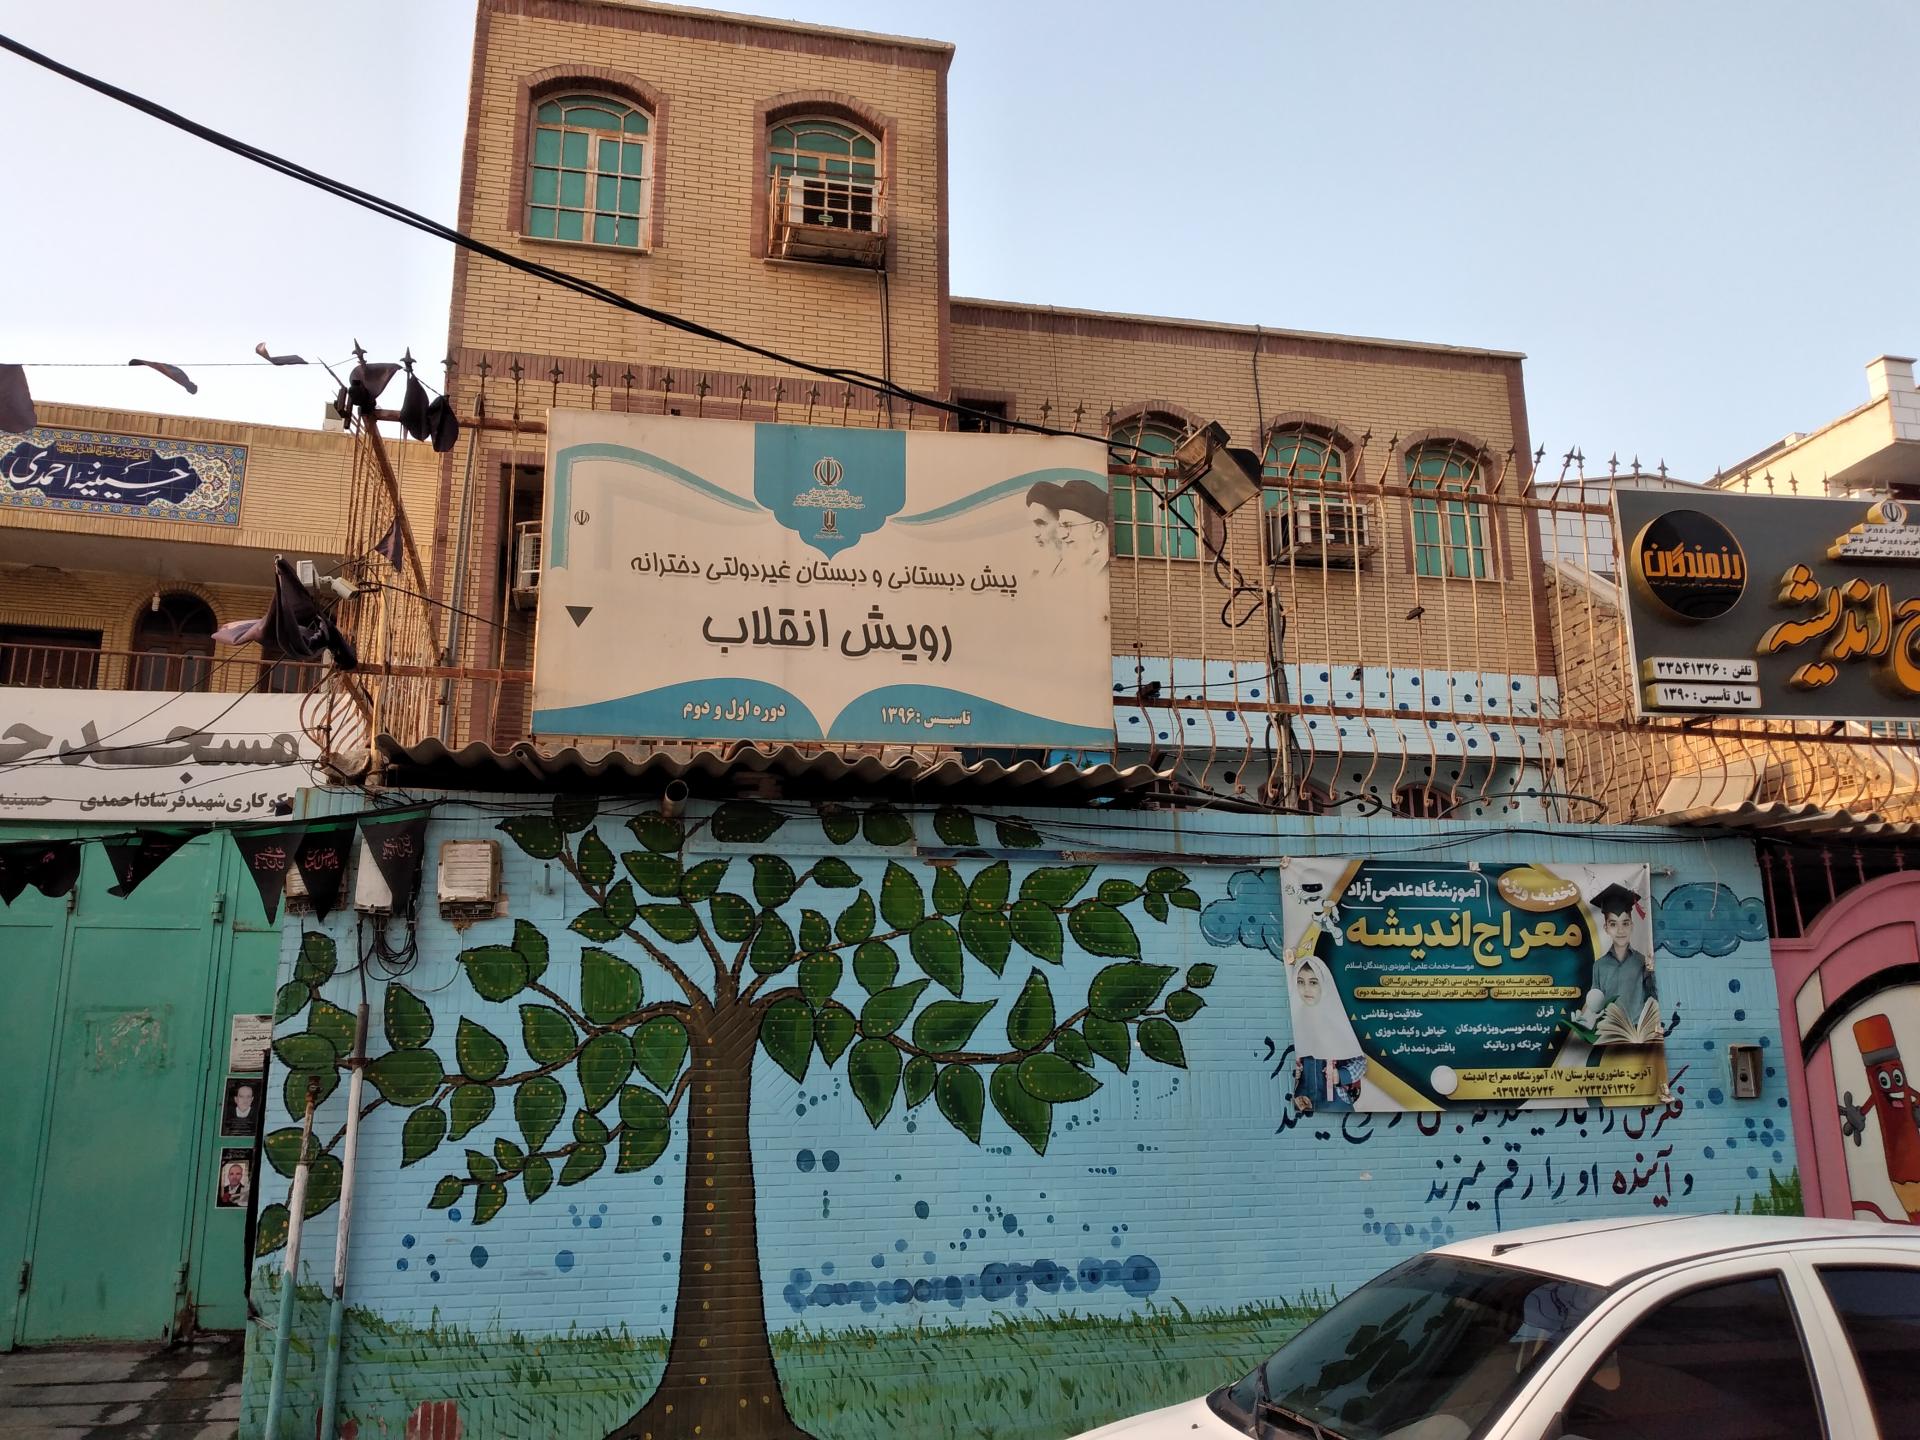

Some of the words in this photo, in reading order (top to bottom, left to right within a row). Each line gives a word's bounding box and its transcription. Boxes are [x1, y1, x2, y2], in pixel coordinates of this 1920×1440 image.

[8, 450, 74, 488] احمدی
[630, 551, 701, 578] دخترانه
[705, 556, 791, 584] غیردولتی
[1643, 542, 1742, 580] رزمندگان
[796, 560, 867, 587] دبستان
[872, 568, 883, 588] و
[887, 565, 965, 592] دبستانی
[970, 564, 1018, 598] پیش
[702, 605, 829, 655] انقلاب
[840, 604, 953, 663] رویش
[1768, 563, 1892, 687] اندیشه
[1657, 661, 1720, 676] ۳۳۵۴۱۳۲۶
[1732, 665, 1752, 679] تلفن
[1663, 687, 1690, 701] ۱۳۹۰
[1733, 688, 1752, 704] سال
[682, 700, 711, 722] دوم
[713, 705, 722, 722] و
[724, 698, 751, 722] اول
[752, 702, 786, 723] دوره
[58, 719, 300, 785] مسجد
[79, 791, 140, 812] احمدی
[186, 792, 226, 812] شهید
[1347, 877, 1372, 902] آزاد
[1371, 880, 1414, 903] علمی
[1414, 879, 1481, 903] آموزشگاه
[1501, 877, 1529, 901] ویژه
[1530, 883, 1578, 906] تخفیف
[1346, 908, 1471, 960] اندیشه
[1472, 910, 1583, 967] معراج
[1344, 961, 1362, 972] اسلام
[1362, 960, 1388, 972] رزمندگان
[1411, 962, 1428, 972] علمی
[1430, 962, 1451, 970] خدمات
[1360, 1008, 1389, 1020] نقاشی
[1393, 1008, 1423, 1020] خلاقیت
[1536, 1005, 1555, 1018] قرآن
[1375, 1027, 1396, 1038] دوزی
[1396, 1025, 1415, 1038] کیف
[1421, 1025, 1447, 1038] خیاطی
[1454, 1023, 1482, 1035] کودکان
[1482, 1025, 1499, 1035] ویژه
[1526, 1023, 1550, 1035] برنامه
[1430, 1041, 1456, 1055] بافتنی
[1482, 1040, 1510, 1052] رباتیک
[1510, 1042, 1516, 1051] و
[1516, 1040, 1542, 1052] چرتکه
[1462, 1071, 1488, 1083] اندیشه
[1488, 1071, 1512, 1084] معراج
[1512, 1069, 1549, 1083] آموزشگاه
[1565, 1069, 1595, 1082] بهارستان
[1545, 1155, 1566, 1201] را
[1576, 1161, 1599, 1198] او
[1612, 1143, 1674, 1208] آینده
[1681, 1173, 1694, 1197] و
